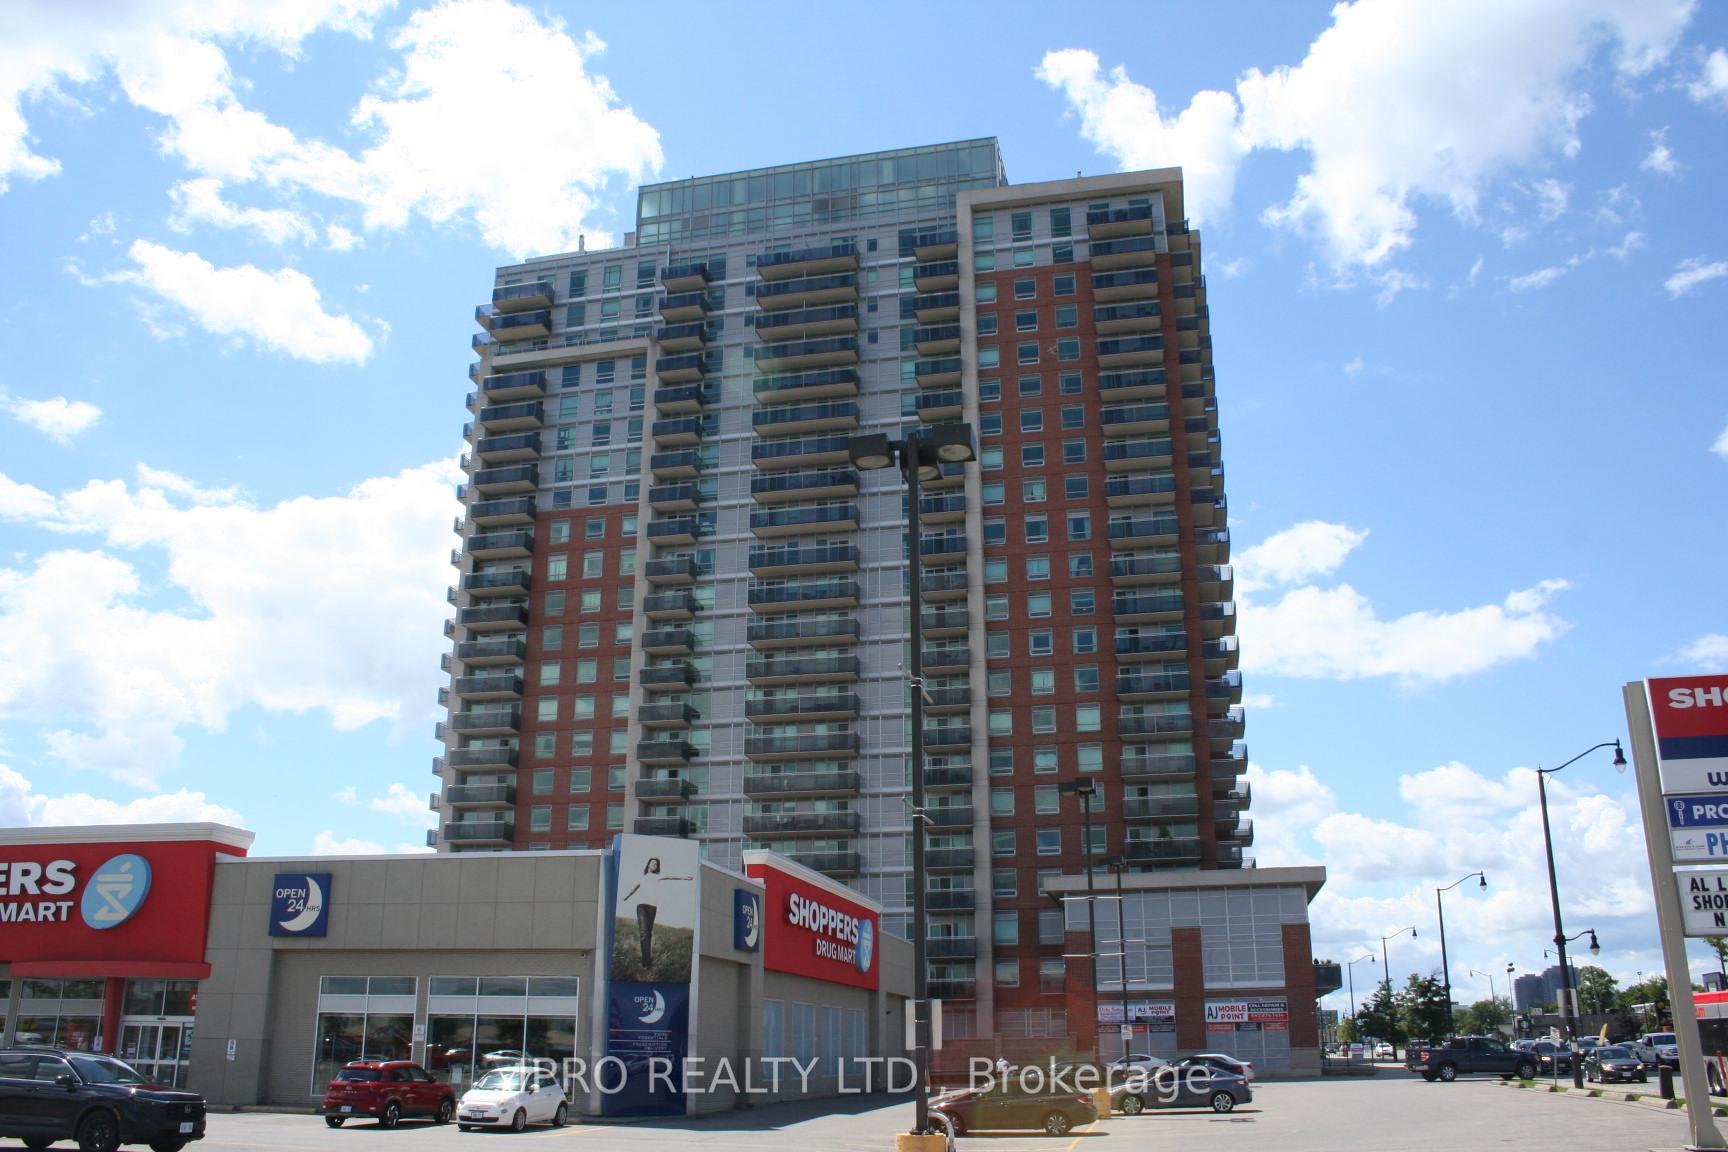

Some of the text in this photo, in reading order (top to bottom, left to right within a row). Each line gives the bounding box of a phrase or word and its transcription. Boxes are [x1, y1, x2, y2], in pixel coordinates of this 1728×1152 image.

[1668, 687, 1728, 709] SH
[276, 888, 306, 899] OPEN
[0, 901, 75, 922] MART
[287, 899, 304, 912] 24
[788, 893, 859, 945] SHOPPERS
[816, 938, 856, 965] DRUG MART
[634, 995, 654, 1004] OPEN
[642, 1003, 654, 1012] 24
[1207, 1005, 1218, 1020] AJ
[1218, 1005, 1246, 1013] MOBILE
